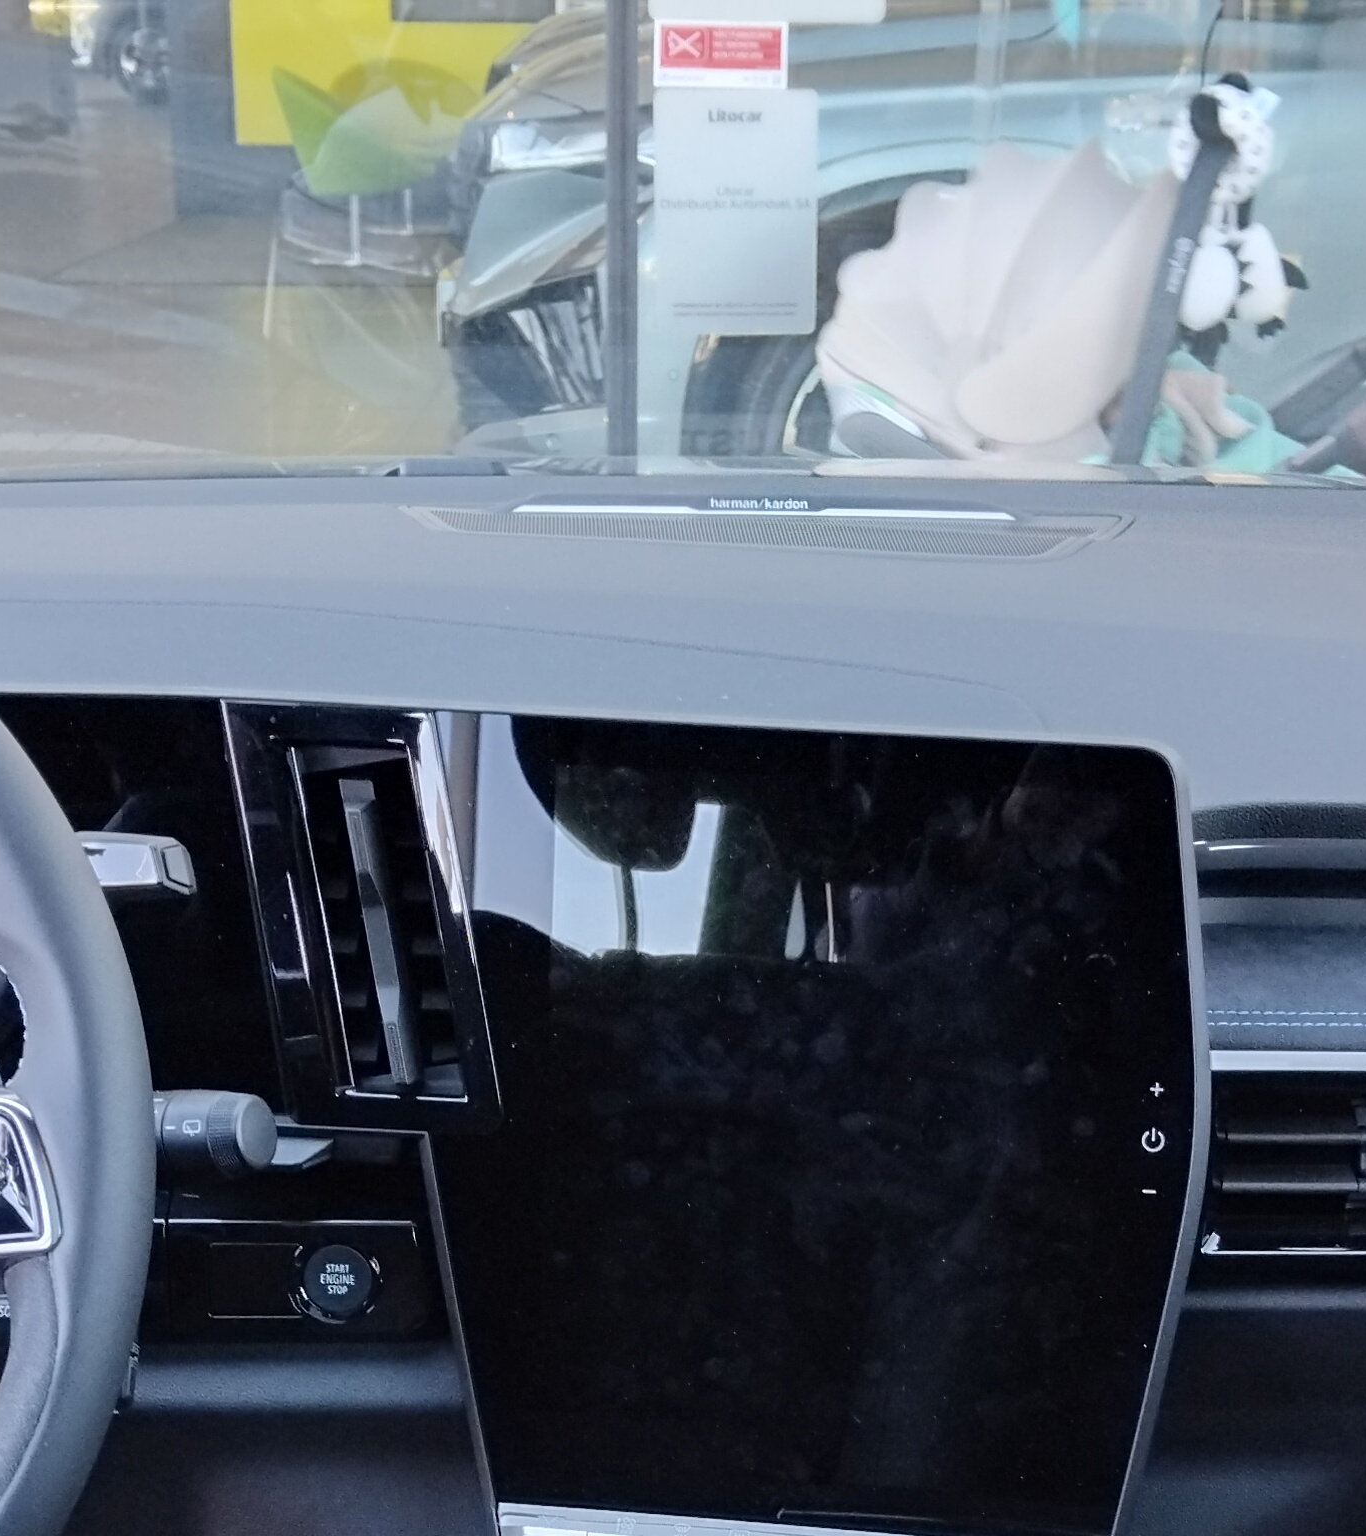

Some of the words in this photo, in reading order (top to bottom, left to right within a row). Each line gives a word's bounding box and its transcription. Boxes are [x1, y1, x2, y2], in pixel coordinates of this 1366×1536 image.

[708, 108, 763, 123] Litocar
[710, 496, 809, 511] harman/kardon
[325, 1263, 350, 1274] START
[320, 1273, 356, 1286] ENGINE
[327, 1285, 349, 1295] STOP
